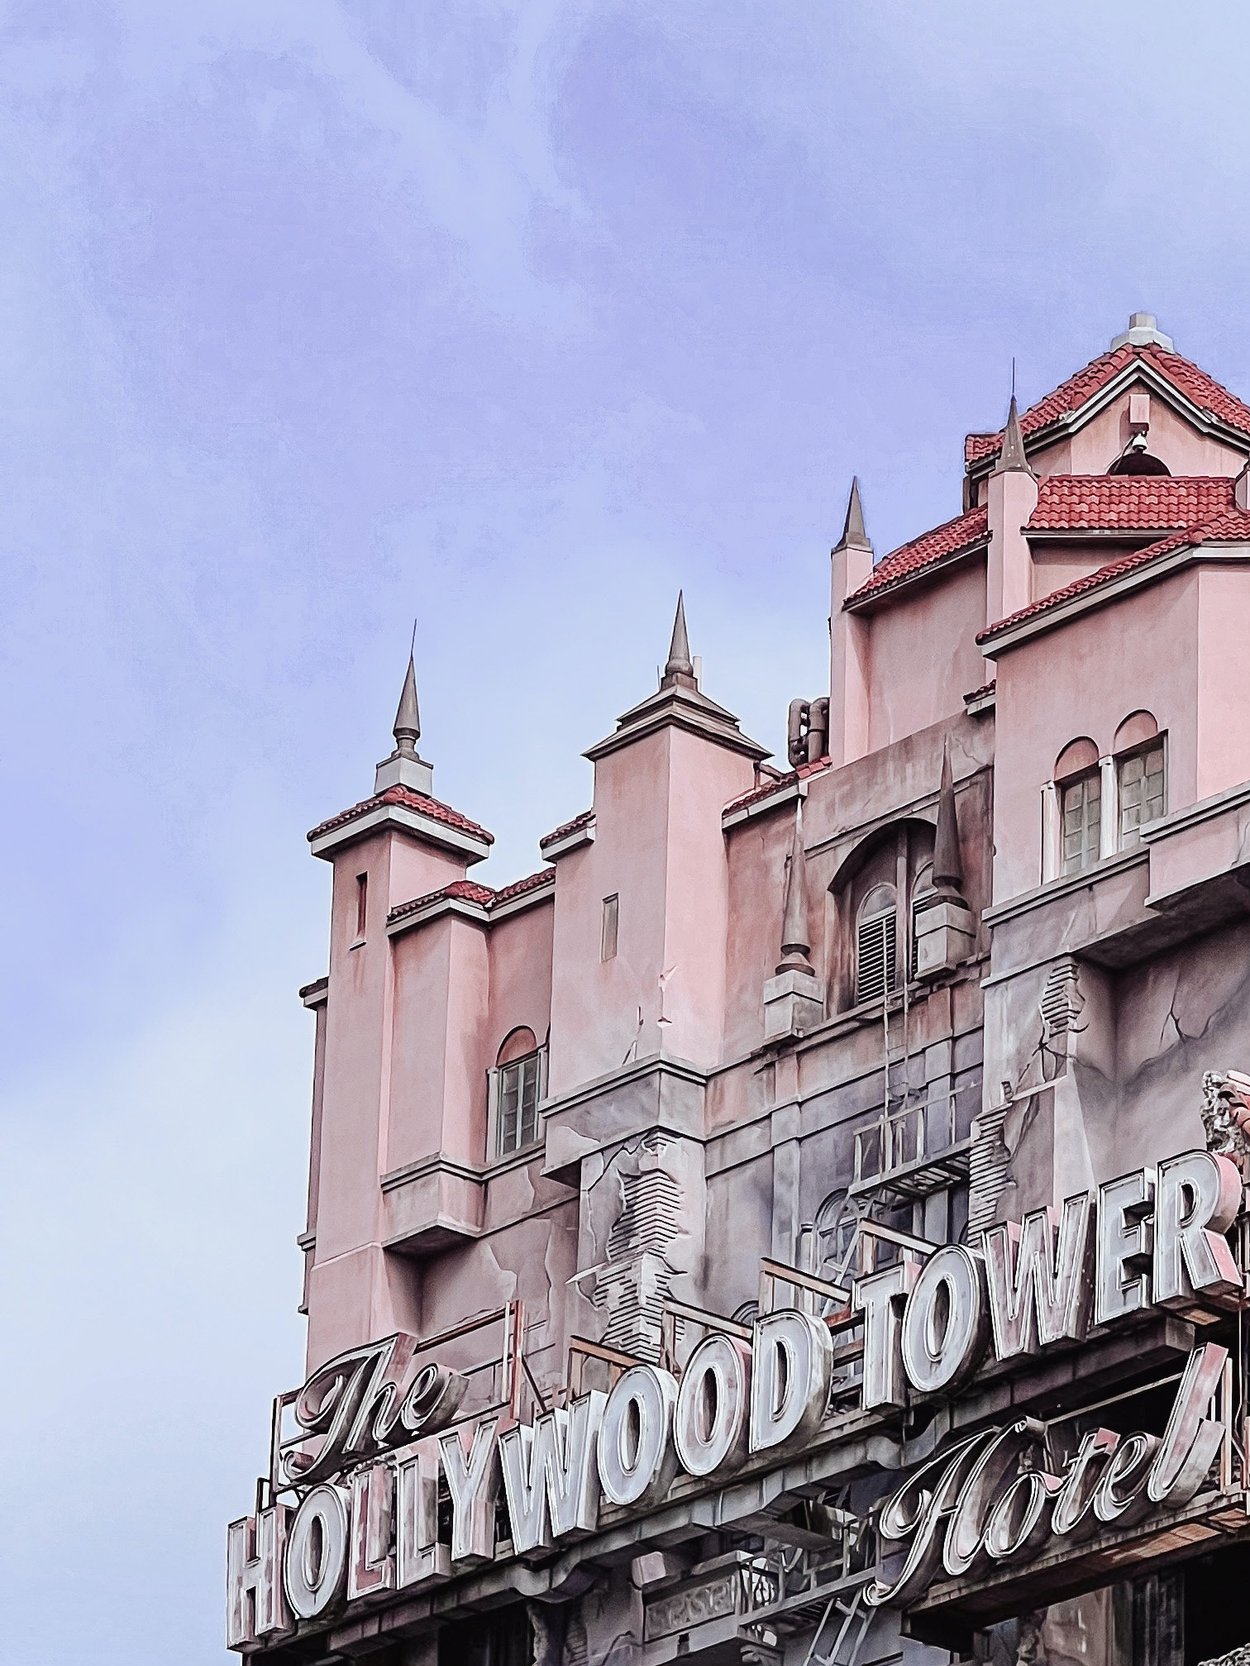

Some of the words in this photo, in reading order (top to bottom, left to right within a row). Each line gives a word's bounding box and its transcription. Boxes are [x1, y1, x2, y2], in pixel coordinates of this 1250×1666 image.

[226, 1307, 834, 1650] HOLLYWOOD
[851, 1148, 1243, 1411] TOWER
[283, 1331, 470, 1484] The
[862, 1341, 1227, 1606] Hotel
